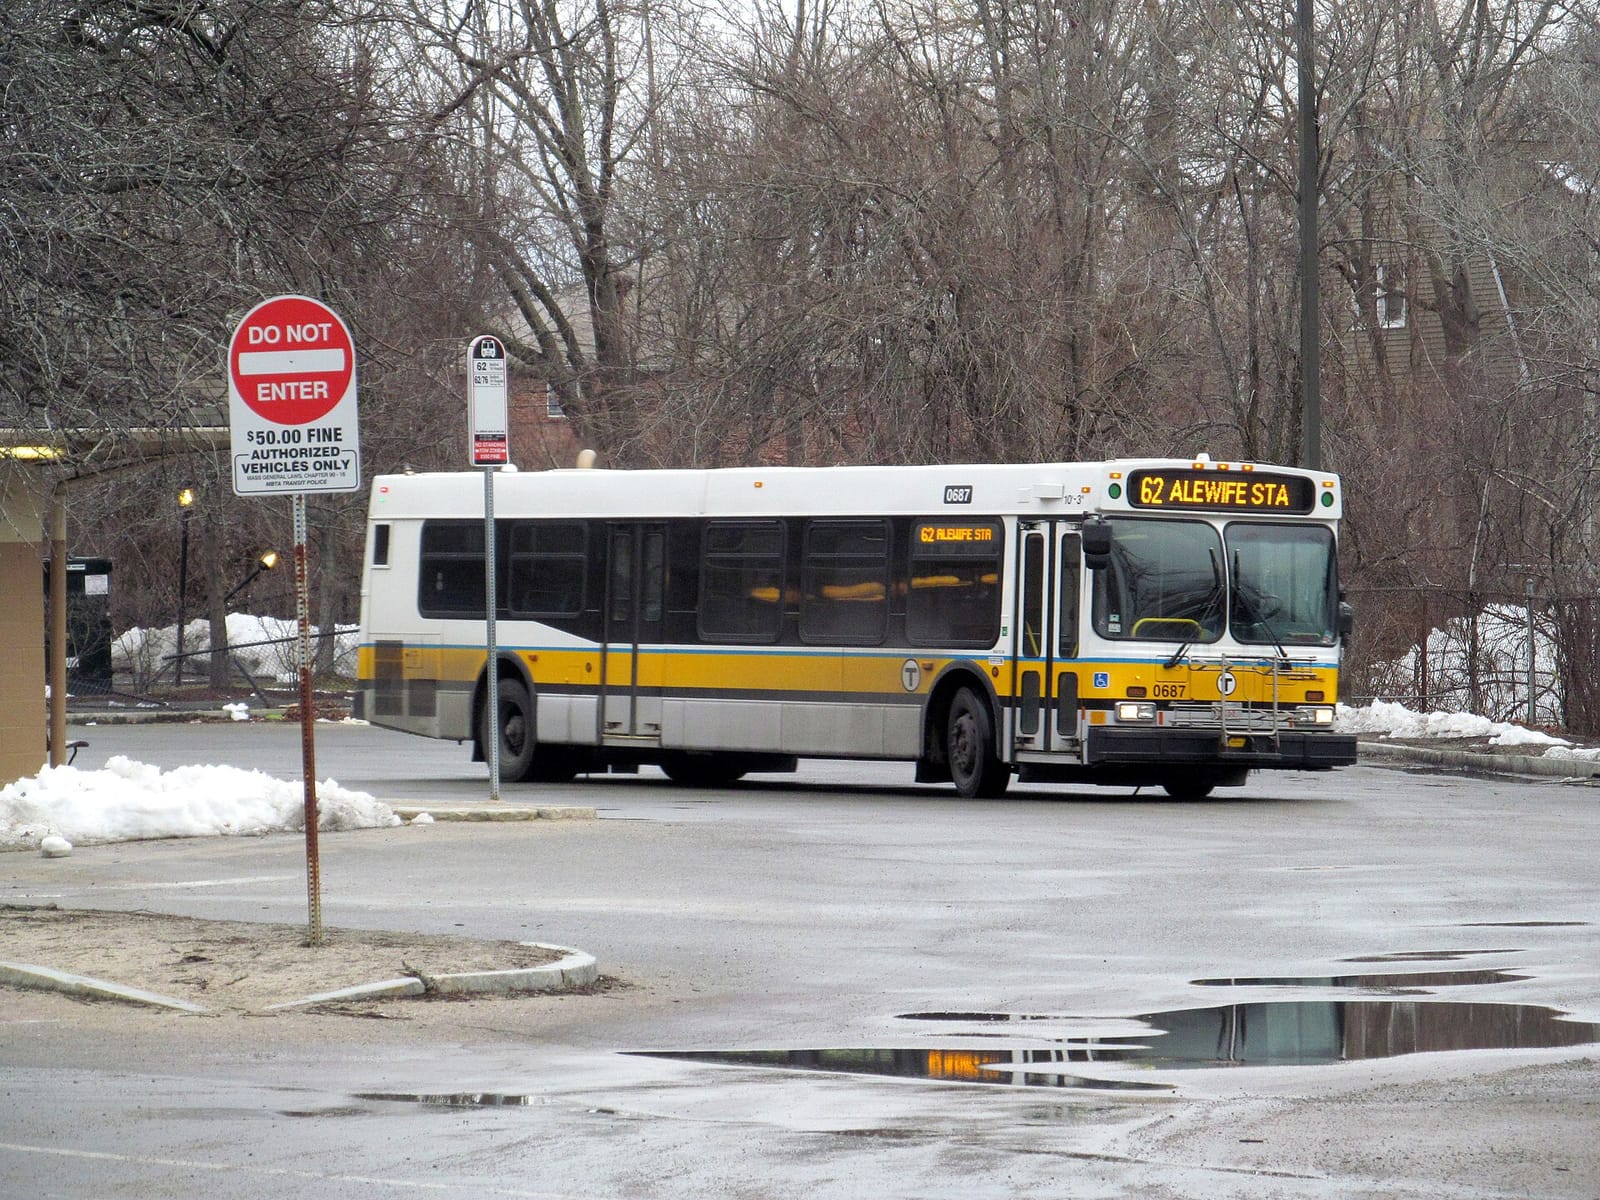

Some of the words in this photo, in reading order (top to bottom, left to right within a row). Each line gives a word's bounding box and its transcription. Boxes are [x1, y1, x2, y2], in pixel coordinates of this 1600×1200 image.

[248, 325, 281, 344] DO
[286, 323, 332, 343] NOT
[477, 362, 487, 371] 62
[257, 381, 329, 401] ENTER
[247, 429, 301, 445] $50.00
[307, 427, 343, 443] FINE
[251, 446, 341, 460] AUTHORIZED
[241, 461, 309, 474] VEHICLES
[313, 459, 350, 471] ONLY
[946, 488, 970, 502] 0687
[1140, 477, 1164, 504] 62
[1169, 480, 1248, 504] ALEWIFE
[1251, 483, 1289, 506] STA
[920, 527, 934, 542] 62
[936, 528, 973, 541] ALEWIFE
[974, 528, 991, 541] STA
[904, 668, 917, 687] T
[1220, 677, 1233, 692] T
[1153, 684, 1186, 698] 0687
